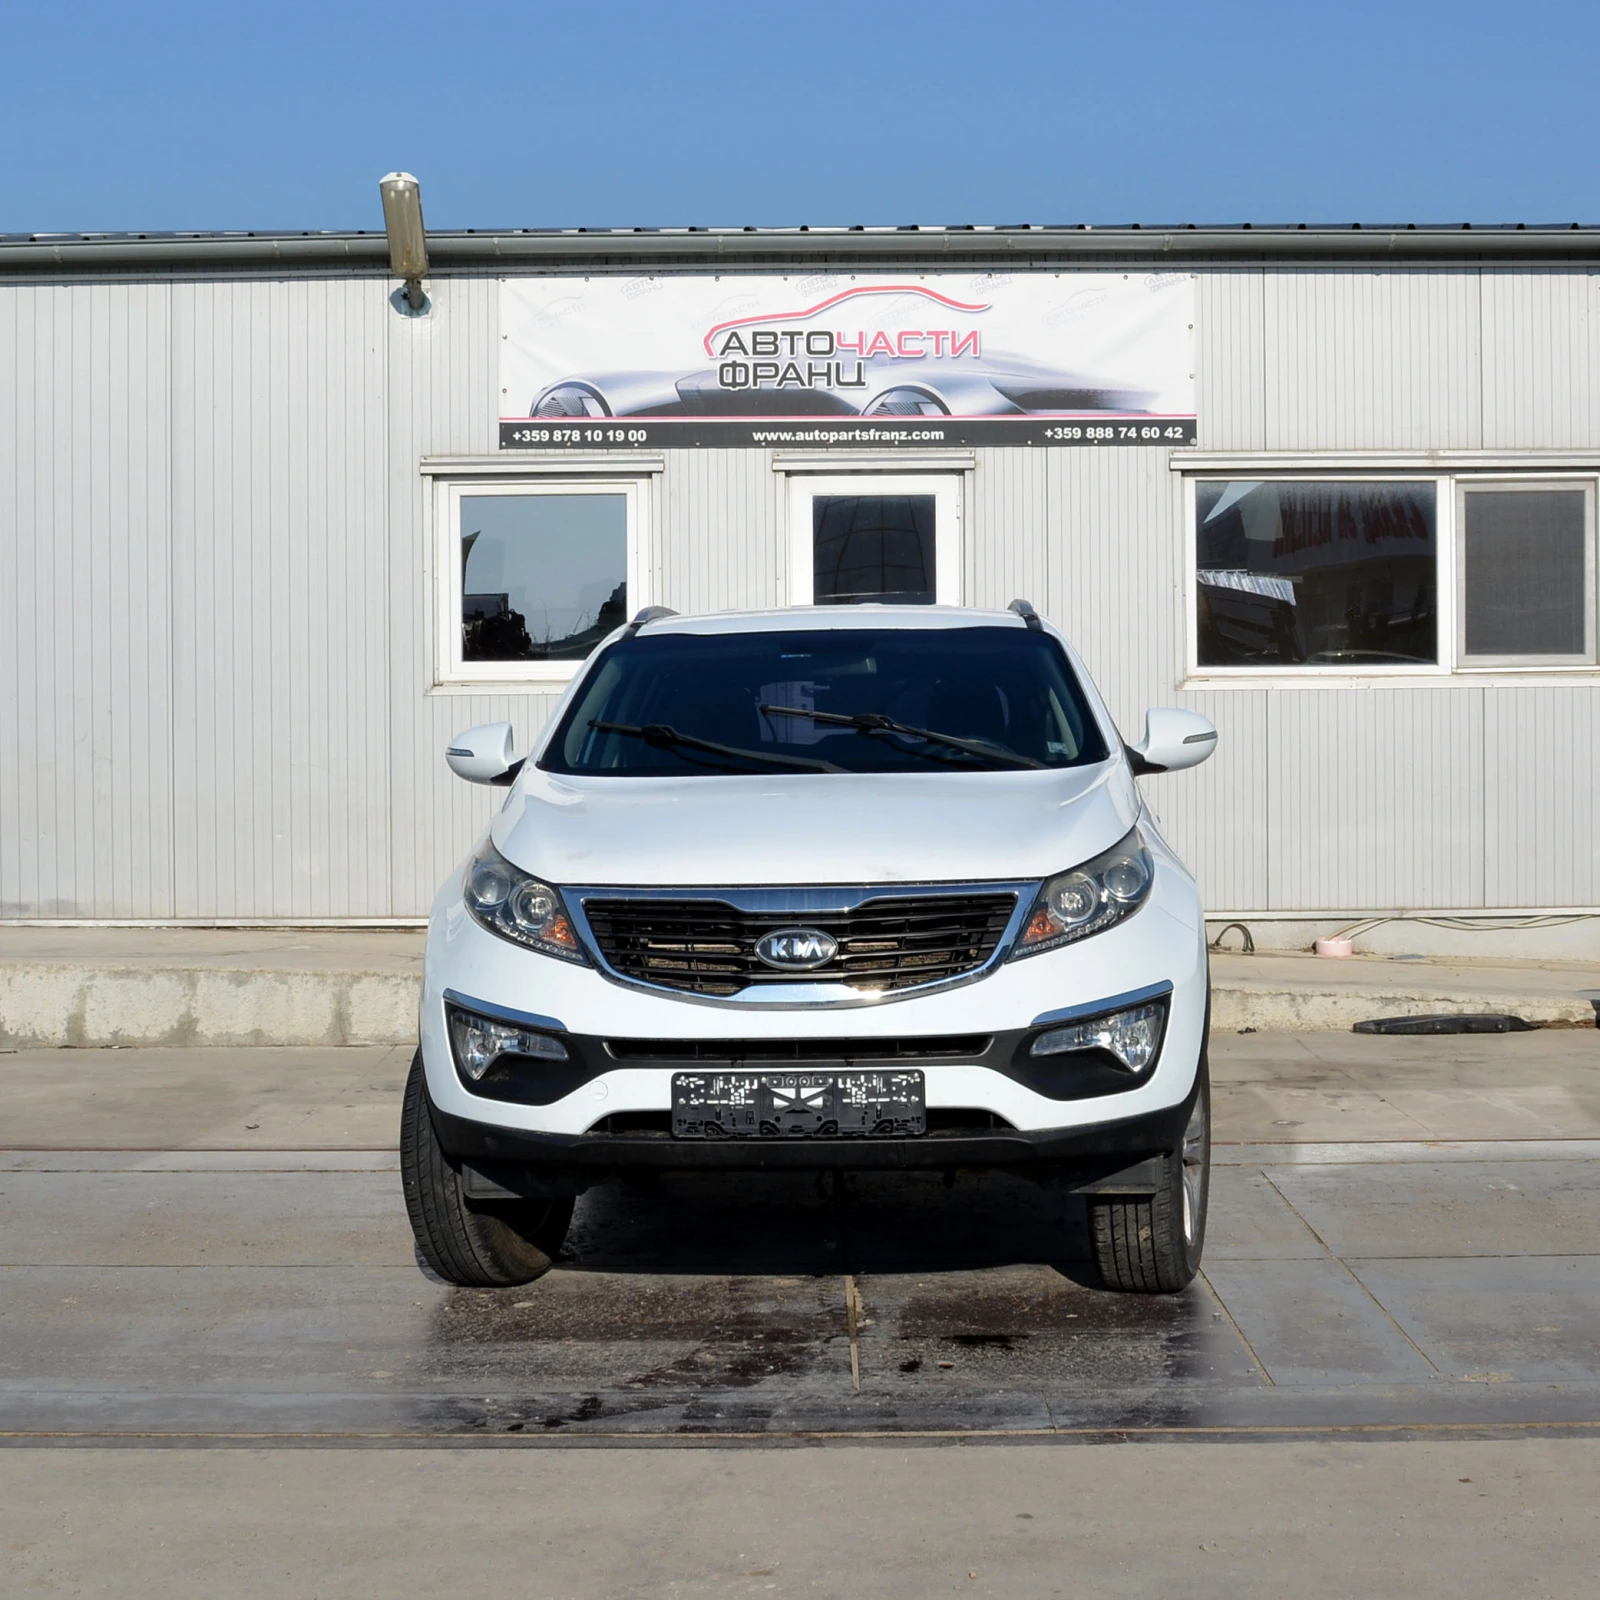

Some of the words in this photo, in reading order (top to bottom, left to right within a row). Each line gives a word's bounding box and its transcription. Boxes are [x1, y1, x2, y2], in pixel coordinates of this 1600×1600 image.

[719, 330, 979, 356] АВТОЧАСТИ
[718, 360, 867, 389] ФРАНЦ
[513, 429, 549, 442] +359
[553, 429, 581, 442] 878
[585, 429, 603, 442] 10
[607, 429, 625, 442] 19
[628, 429, 647, 442] 00
[752, 428, 945, 443] www.autopartsfranz.com
[1044, 427, 1082, 440] +359
[1086, 427, 1114, 439] 888
[1118, 427, 1137, 439] 74
[1141, 426, 1160, 439] 60
[1164, 426, 1183, 439] 42
[770, 936, 823, 959] KIA
